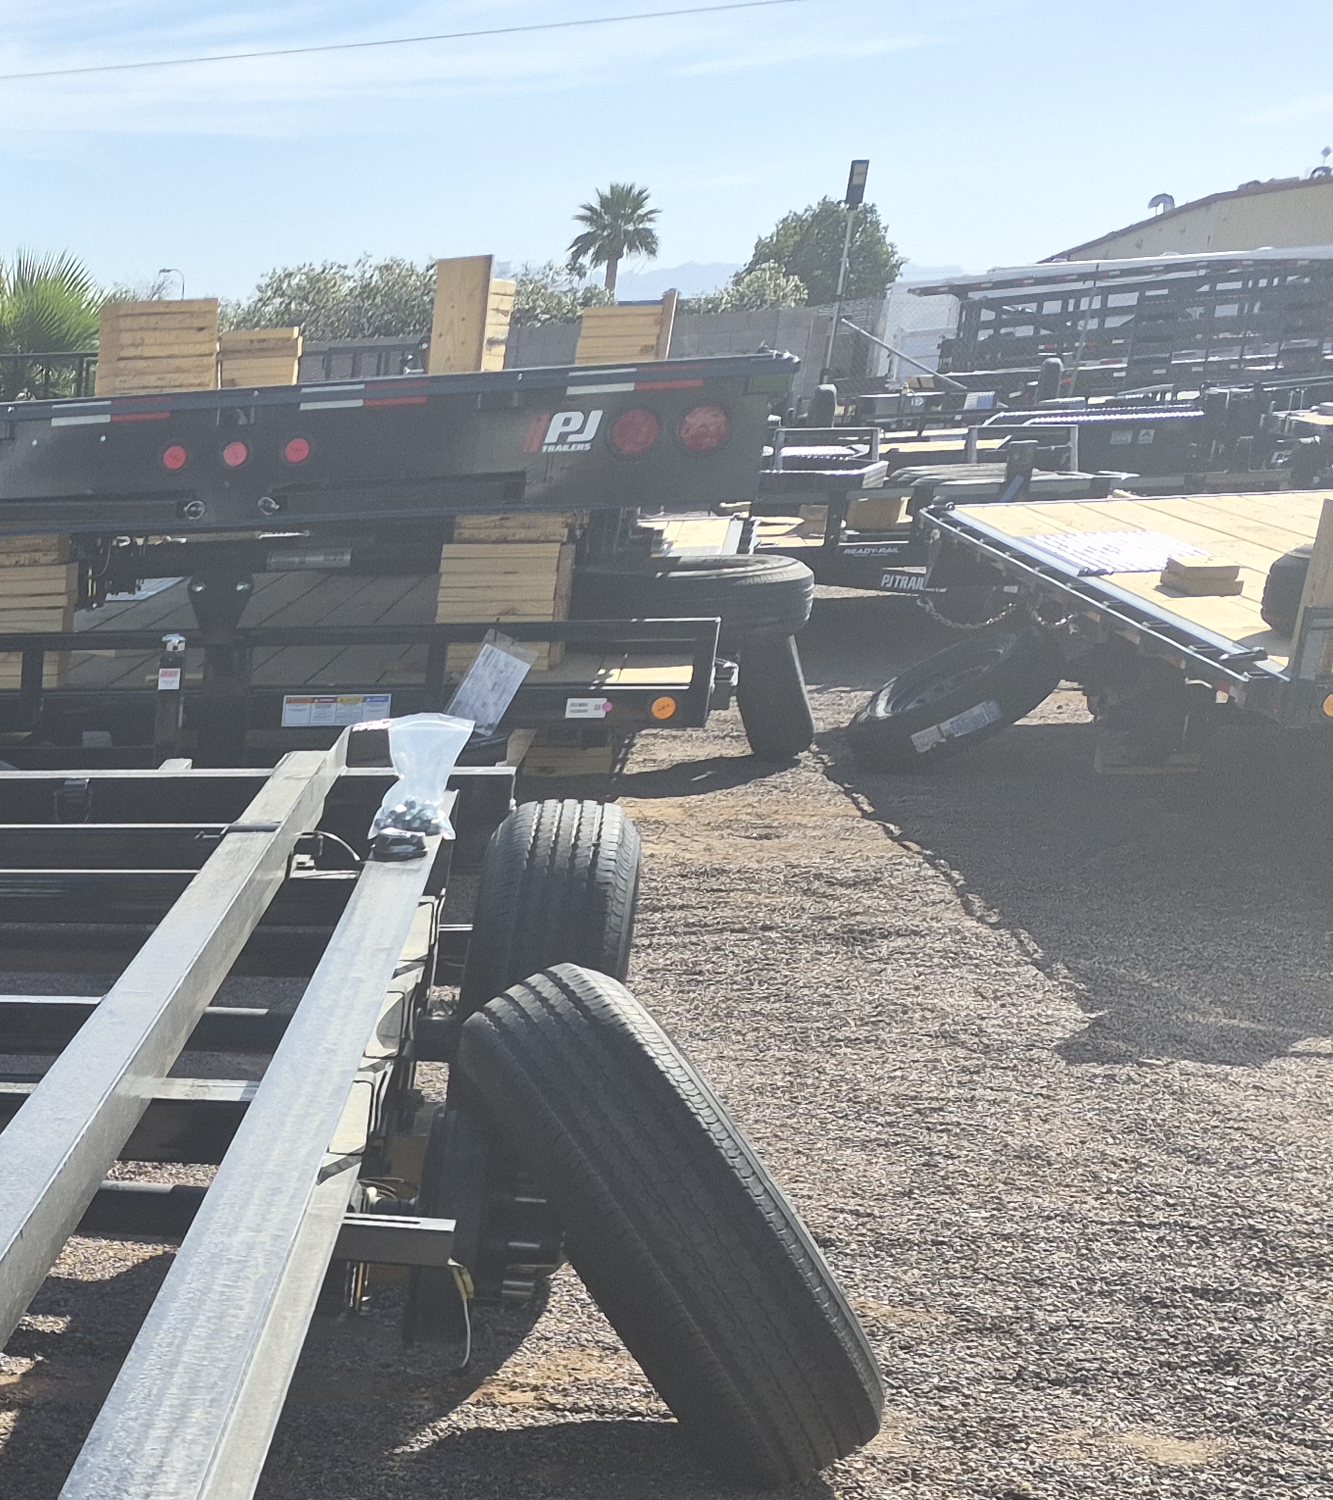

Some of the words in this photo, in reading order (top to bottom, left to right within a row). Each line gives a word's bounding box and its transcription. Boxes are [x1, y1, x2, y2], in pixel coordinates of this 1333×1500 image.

[544, 409, 603, 444] PJ
[542, 443, 591, 453] TRAILERS
[894, 575, 926, 591] TRAIL
